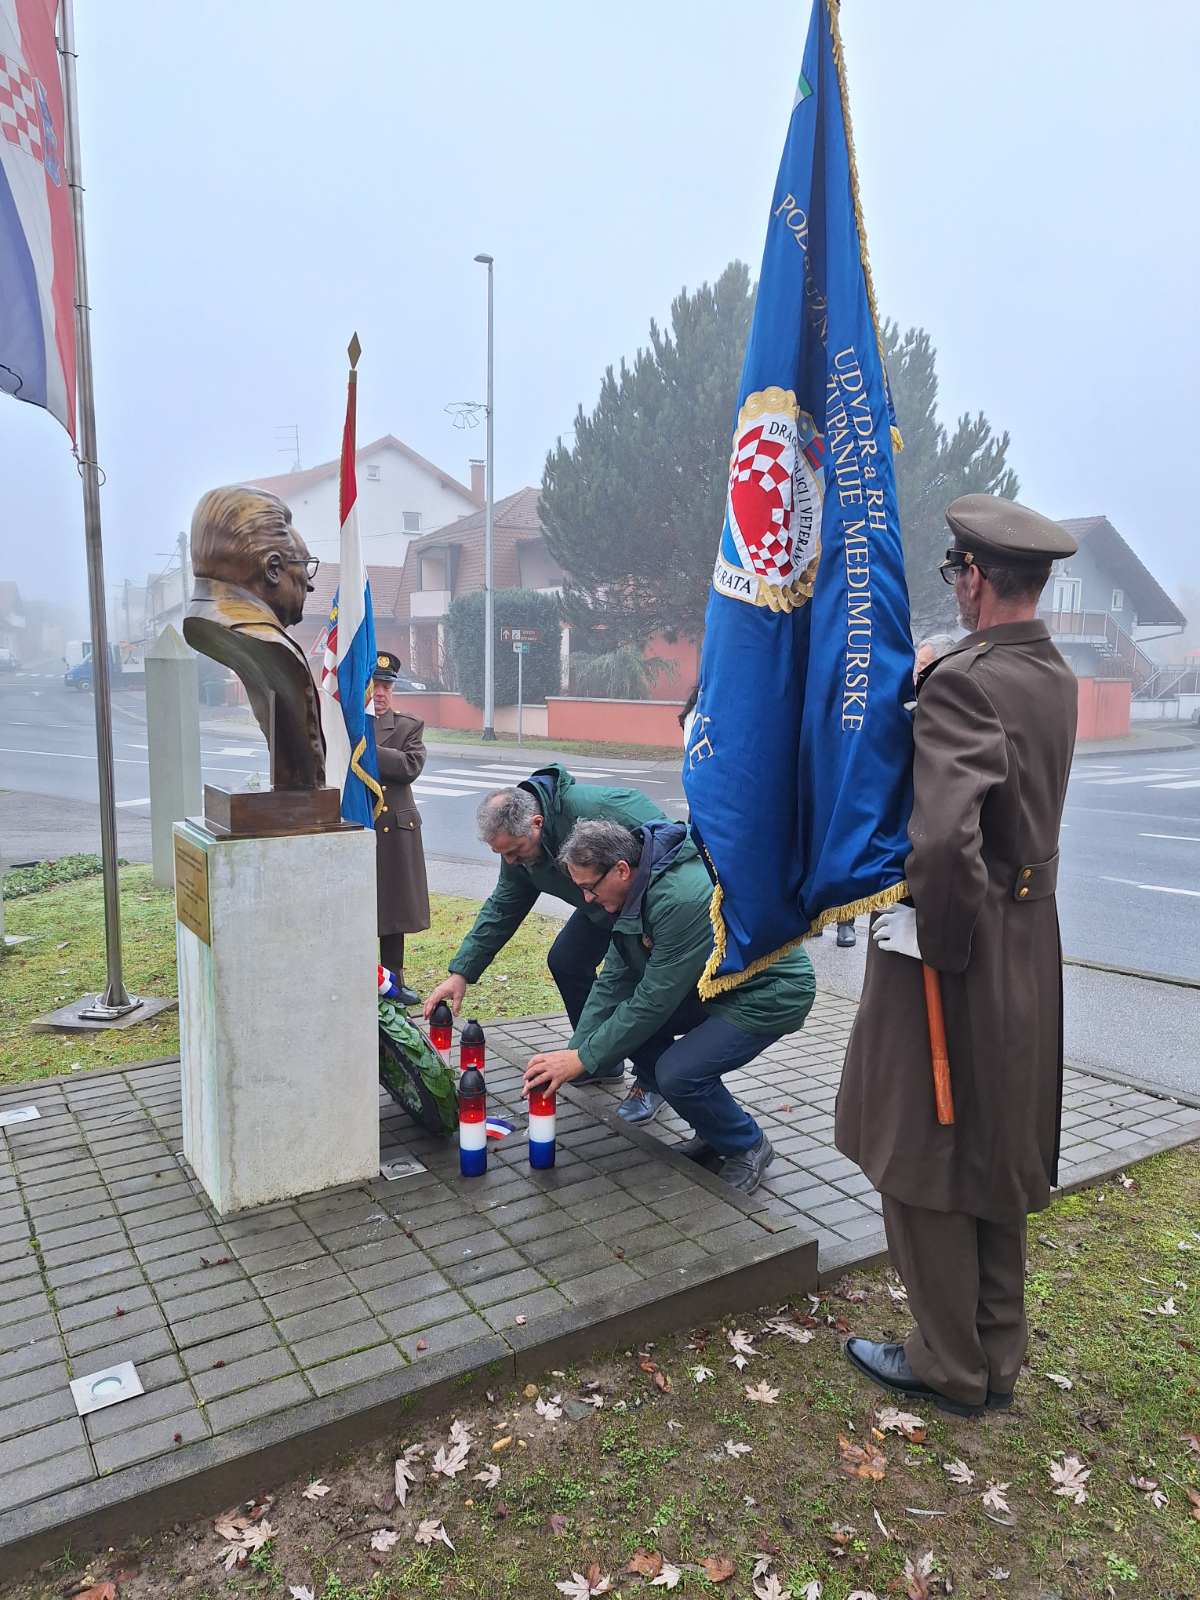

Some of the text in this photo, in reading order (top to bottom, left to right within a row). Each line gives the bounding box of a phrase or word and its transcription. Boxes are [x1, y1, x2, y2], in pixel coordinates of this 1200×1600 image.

[866, 488, 888, 531] RH
[719, 570, 751, 594] RATA
[842, 519, 872, 732] MEĐIMURSKE
